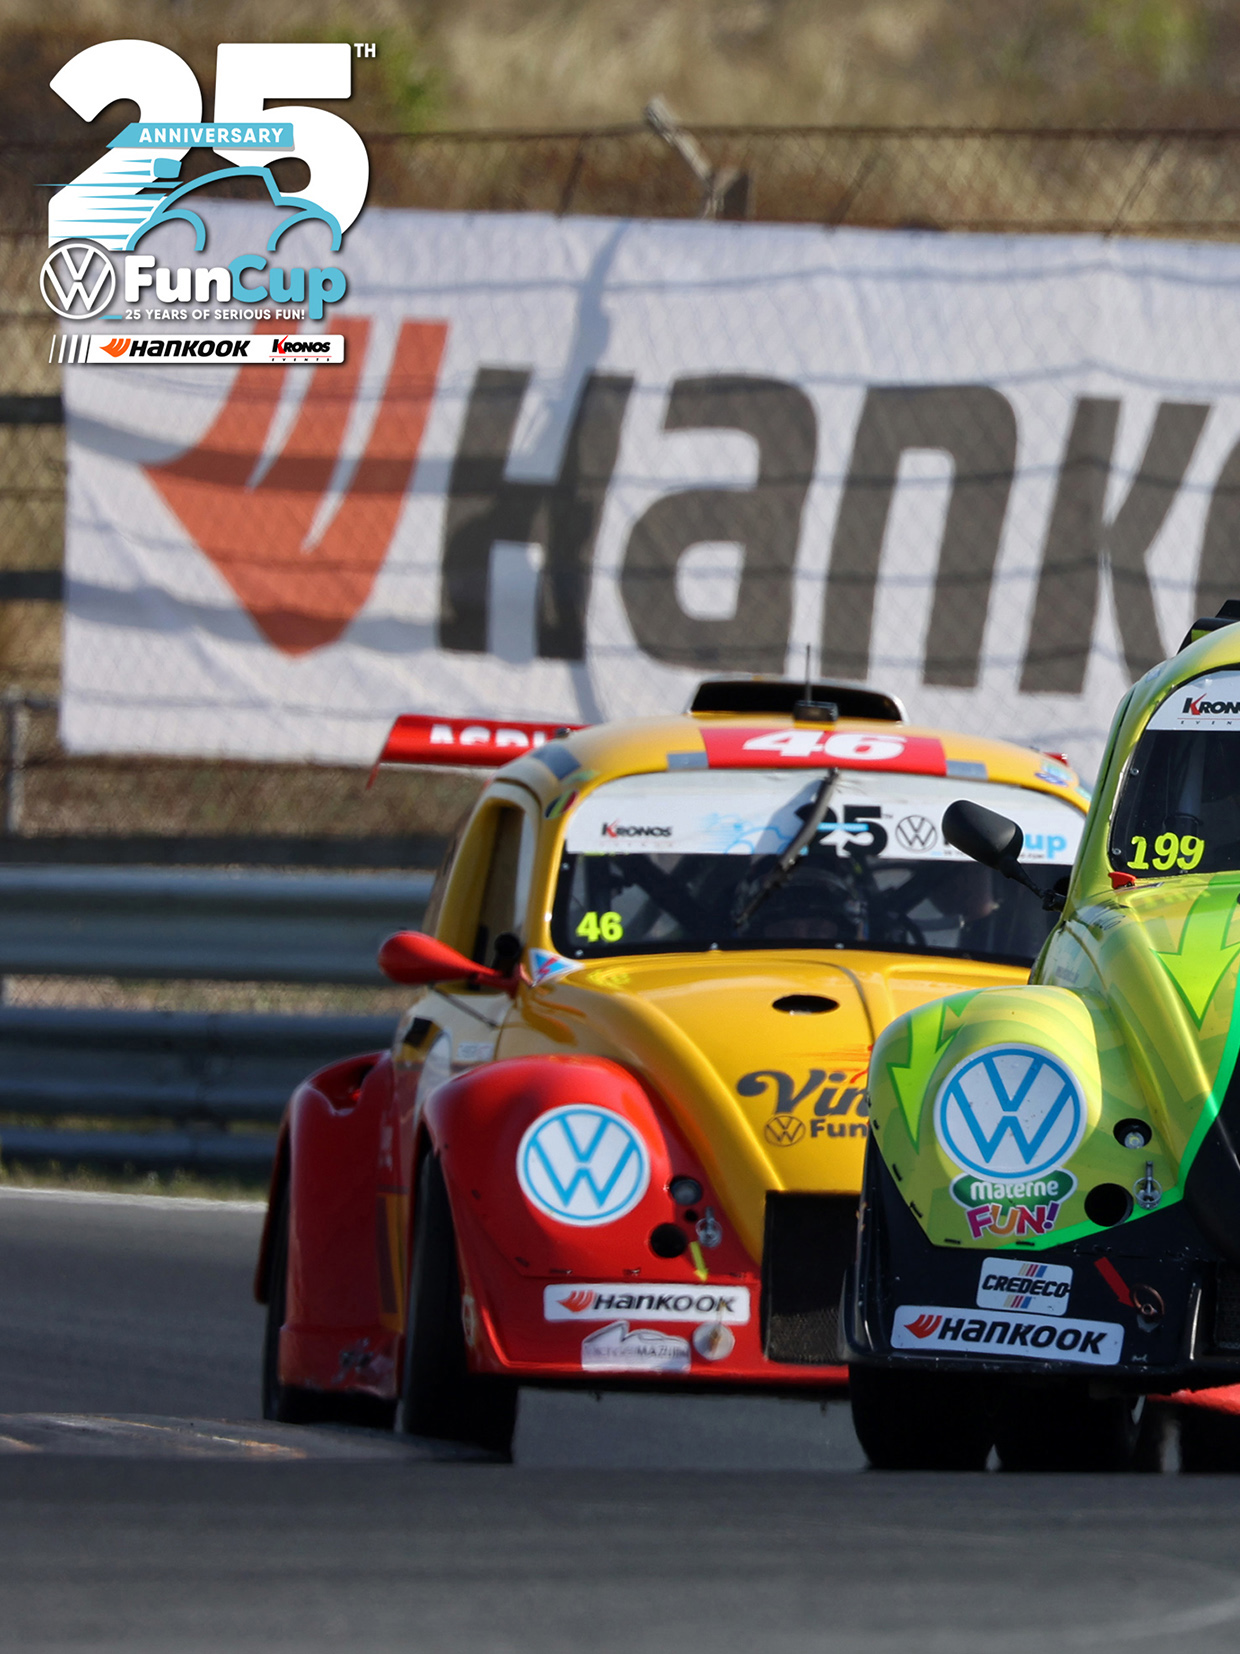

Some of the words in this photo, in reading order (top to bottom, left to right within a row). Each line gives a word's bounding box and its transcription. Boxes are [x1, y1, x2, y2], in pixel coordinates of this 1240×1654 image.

[742, 730, 908, 761] 46
[601, 817, 674, 838] KRONOS
[1127, 832, 1205, 871] 199
[576, 911, 624, 943] 46
[966, 1200, 1061, 1240] FUN!
[981, 1273, 1071, 1298] CREDECO
